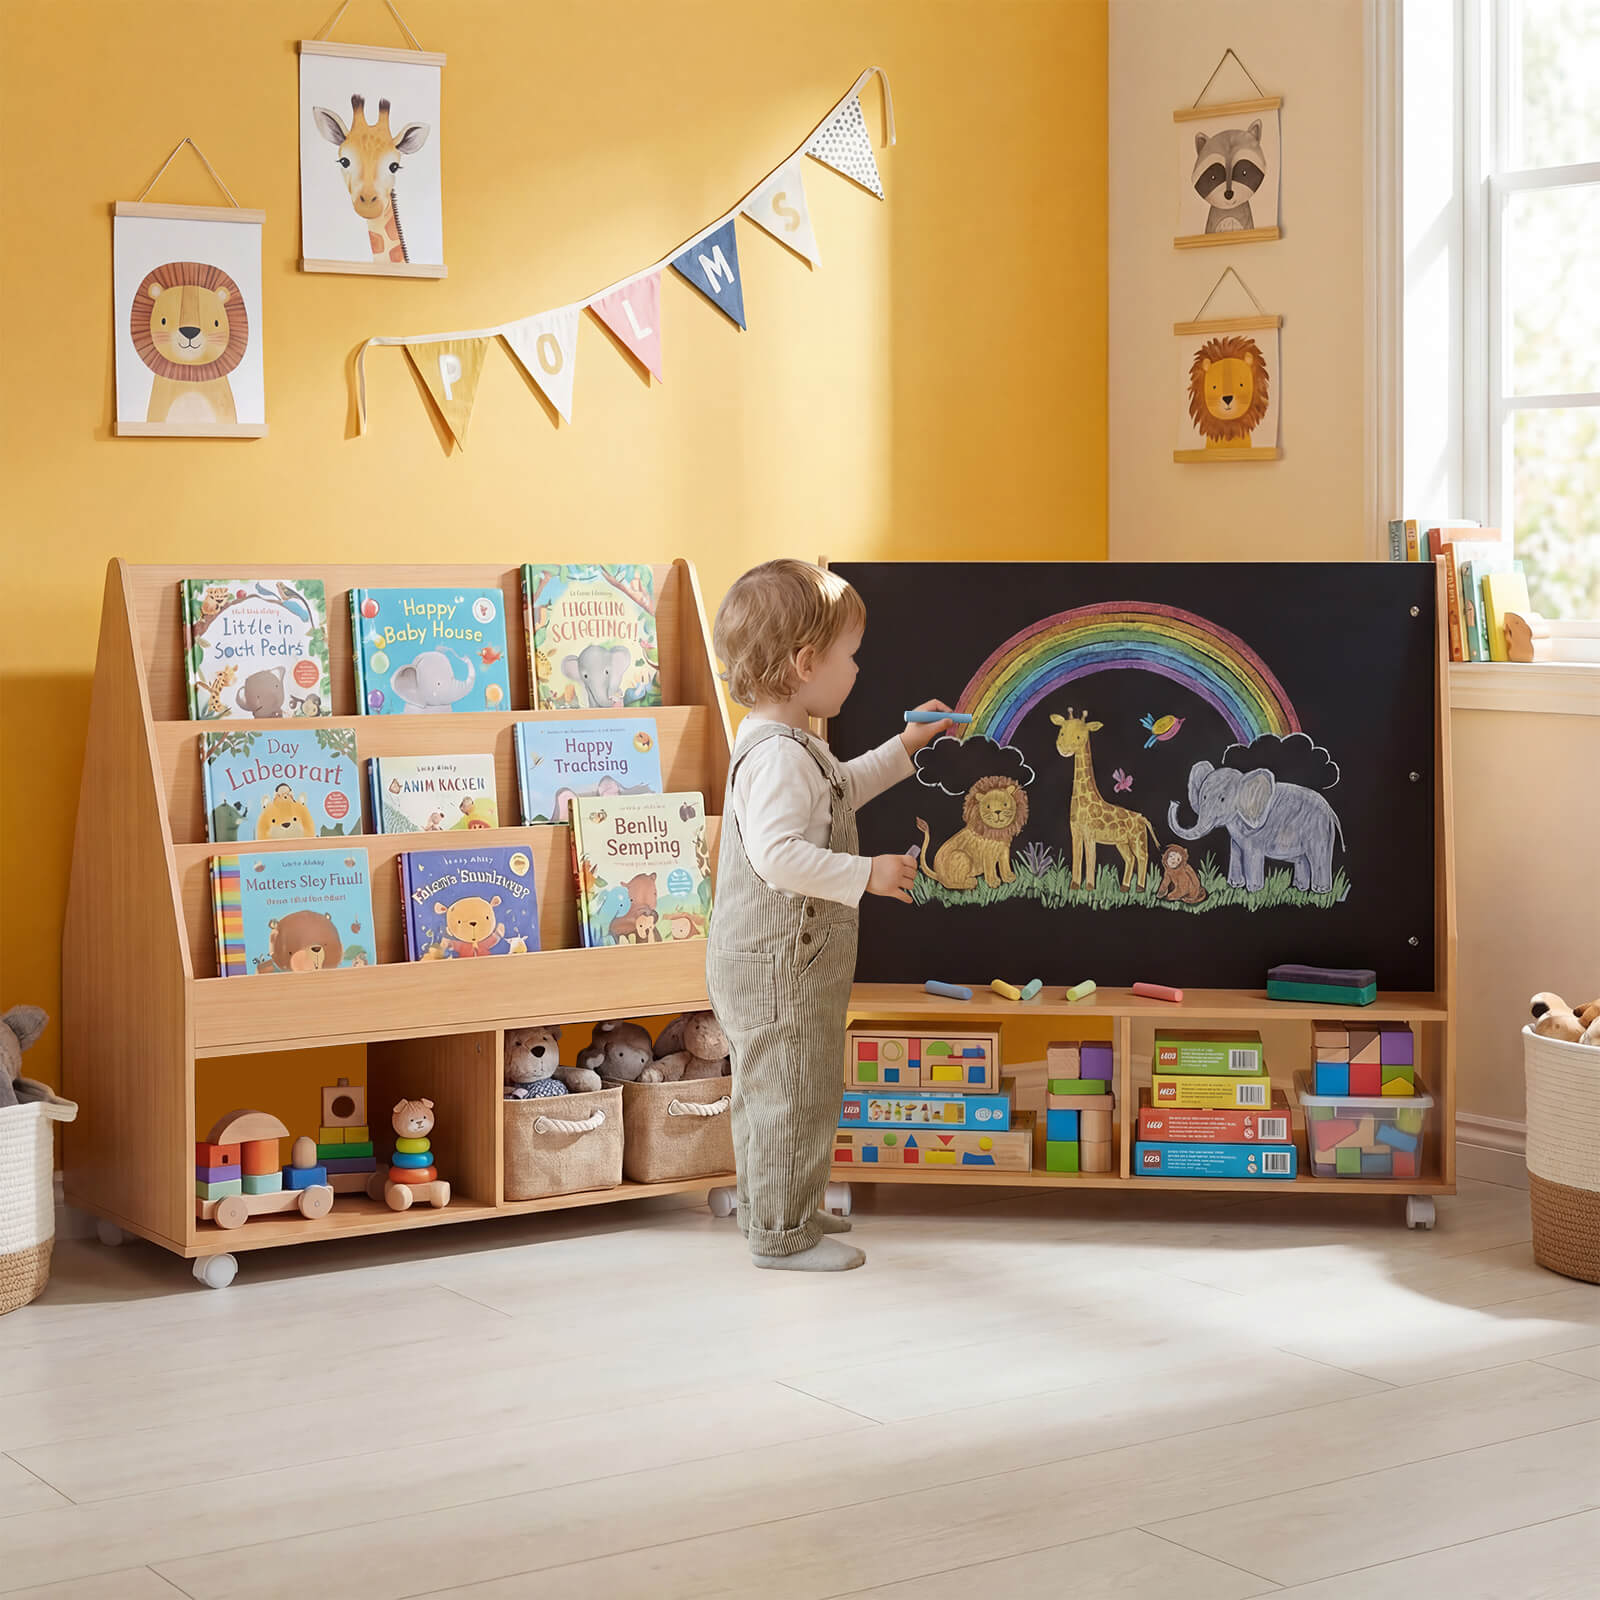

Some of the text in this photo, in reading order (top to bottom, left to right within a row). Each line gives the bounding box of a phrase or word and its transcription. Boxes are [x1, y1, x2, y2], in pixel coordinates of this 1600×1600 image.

[403, 597, 456, 621] Happy
[223, 617, 293, 636] Little in
[384, 620, 483, 645] Baby House
[267, 738, 300, 759] Day
[565, 738, 613, 757] Happy
[225, 758, 343, 791] Lubeorart
[615, 816, 668, 838] Benlly
[607, 836, 680, 859] Semping
[245, 877, 297, 892] Matters
